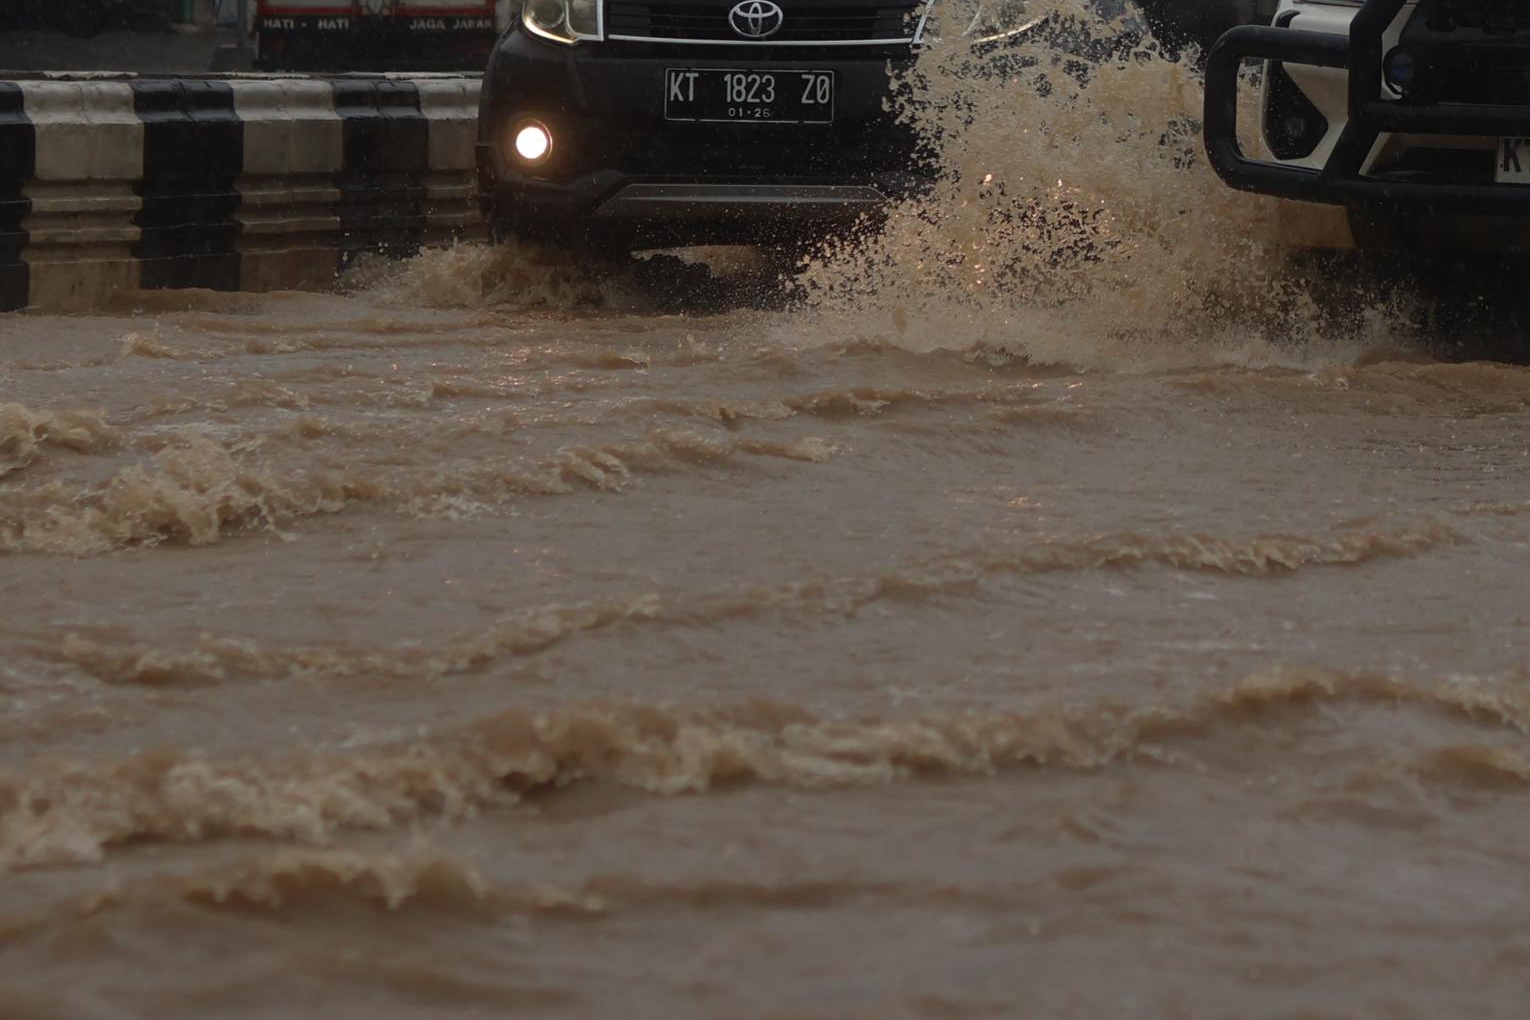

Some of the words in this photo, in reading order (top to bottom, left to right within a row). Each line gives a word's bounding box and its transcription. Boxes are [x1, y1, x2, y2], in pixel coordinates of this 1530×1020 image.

[318, 17, 349, 30] HATI
[409, 17, 445, 30] JAGA
[669, 72, 700, 103] KT
[723, 73, 776, 104] 1823
